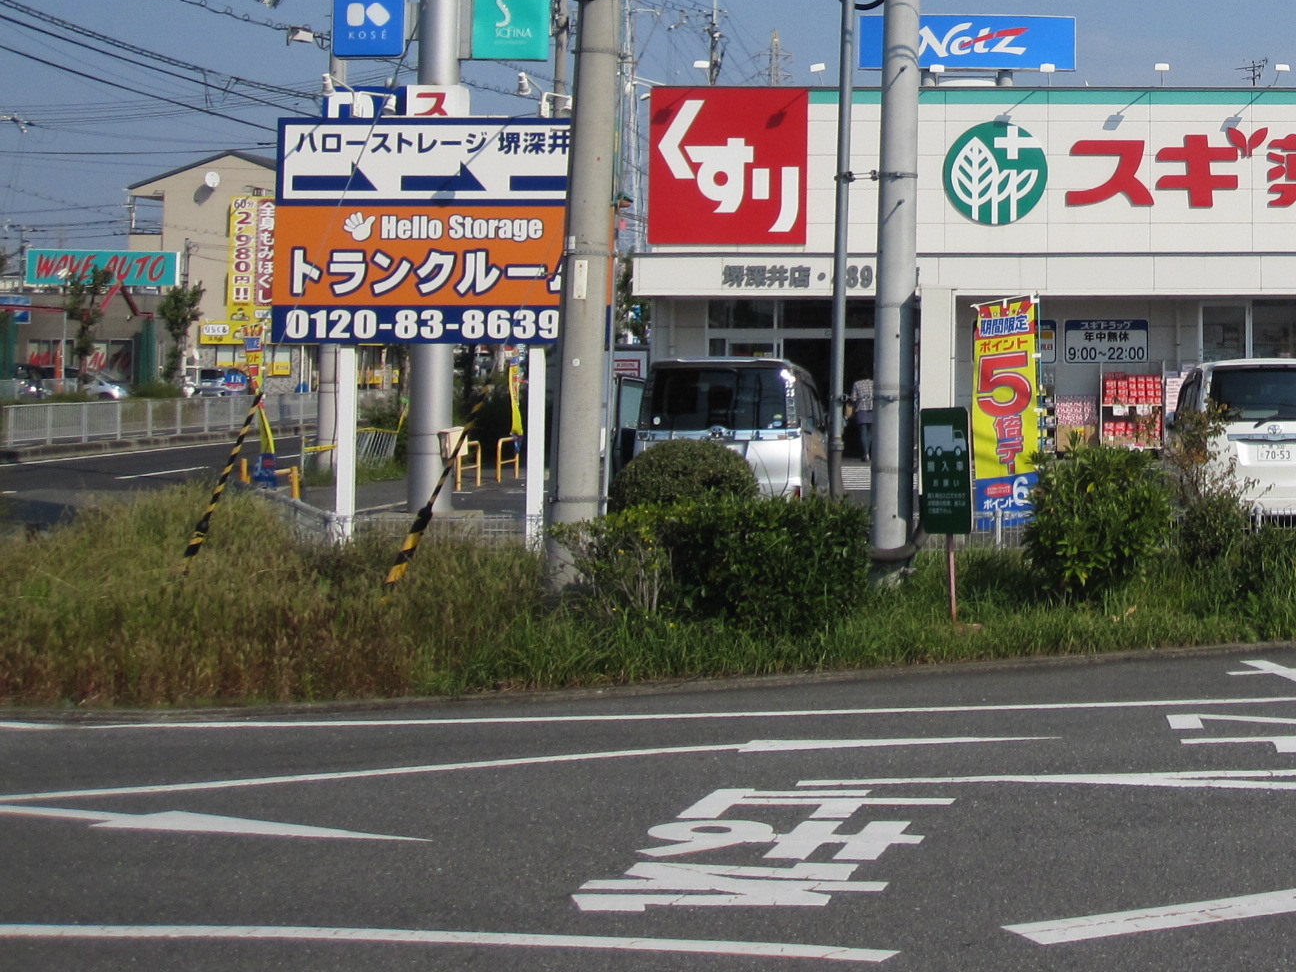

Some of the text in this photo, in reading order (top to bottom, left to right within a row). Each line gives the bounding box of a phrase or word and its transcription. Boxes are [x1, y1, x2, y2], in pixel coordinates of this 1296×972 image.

[348, 29, 387, 40] KOSÉ
[495, 26, 532, 39] SOFINA
[918, 21, 1029, 58] Netz
[296, 131, 487, 155] ハローストレージ
[658, 99, 800, 233] くすり
[380, 214, 543, 242] Hello Storage
[36, 253, 165, 282] WAVE AUTO
[290, 247, 562, 297] トランクルー
[285, 308, 559, 340] 0120-83-8639
[980, 314, 1029, 337] 期間限定
[1080, 320, 1132, 330] スギドラッグ
[1084, 331, 1130, 343] 年中無休
[980, 337, 1029, 353] ポイント
[977, 350, 1032, 417] 5
